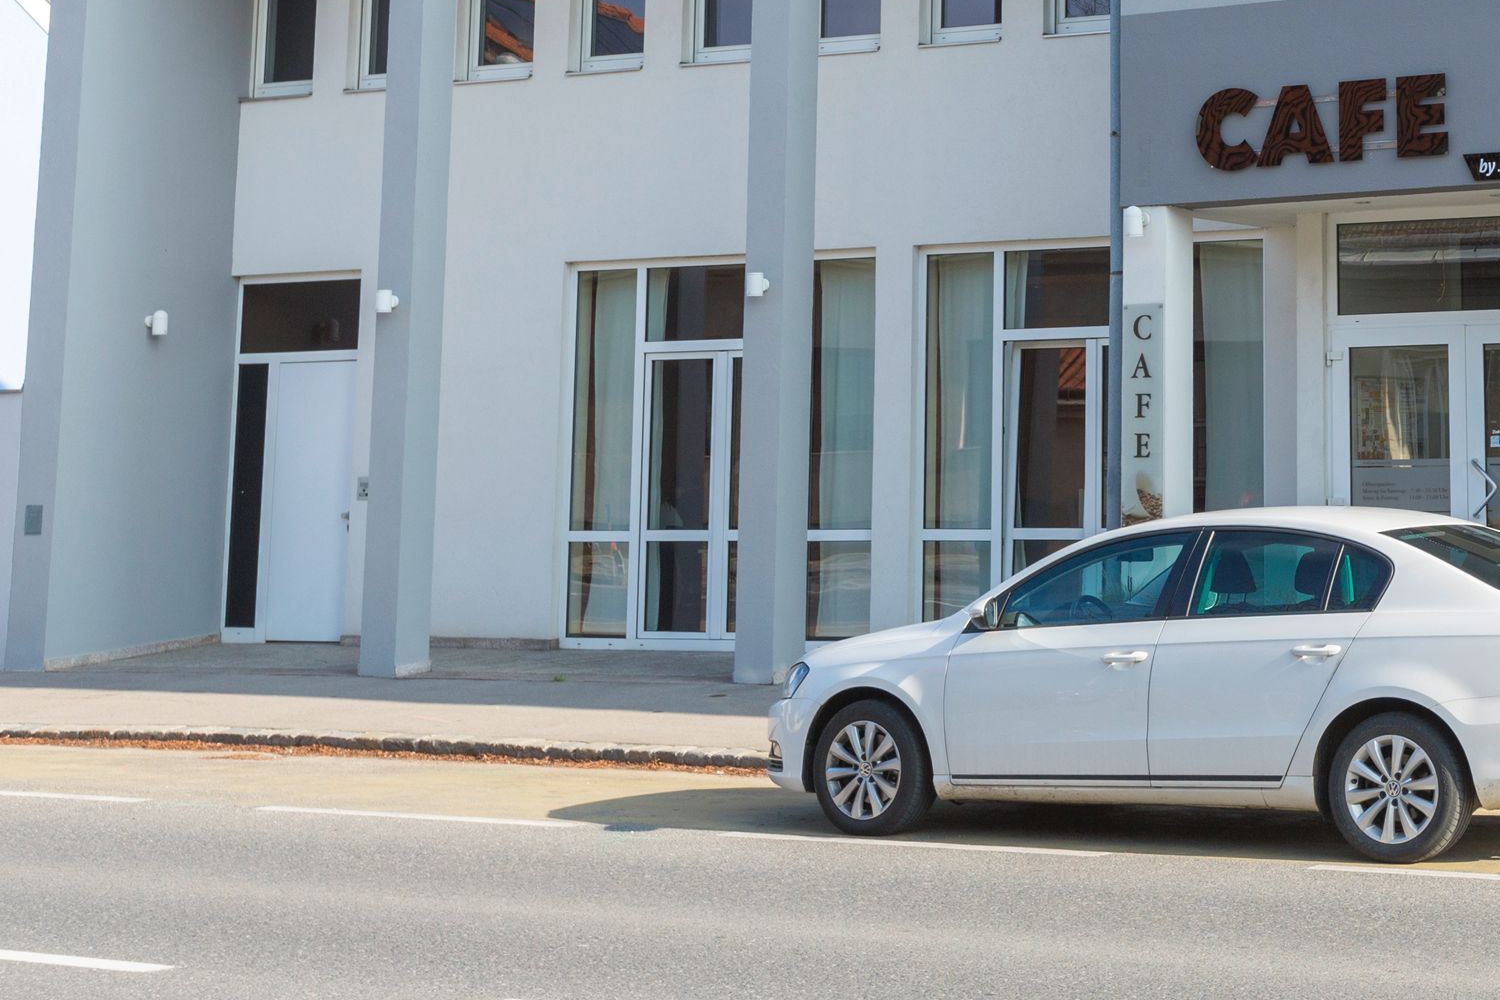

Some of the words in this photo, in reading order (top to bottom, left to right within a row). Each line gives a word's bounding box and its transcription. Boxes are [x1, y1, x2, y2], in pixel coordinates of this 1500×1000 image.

[1196, 73, 1449, 171] CAFE
[1479, 158, 1496, 177] by
[1131, 315, 1152, 458] CAFE
